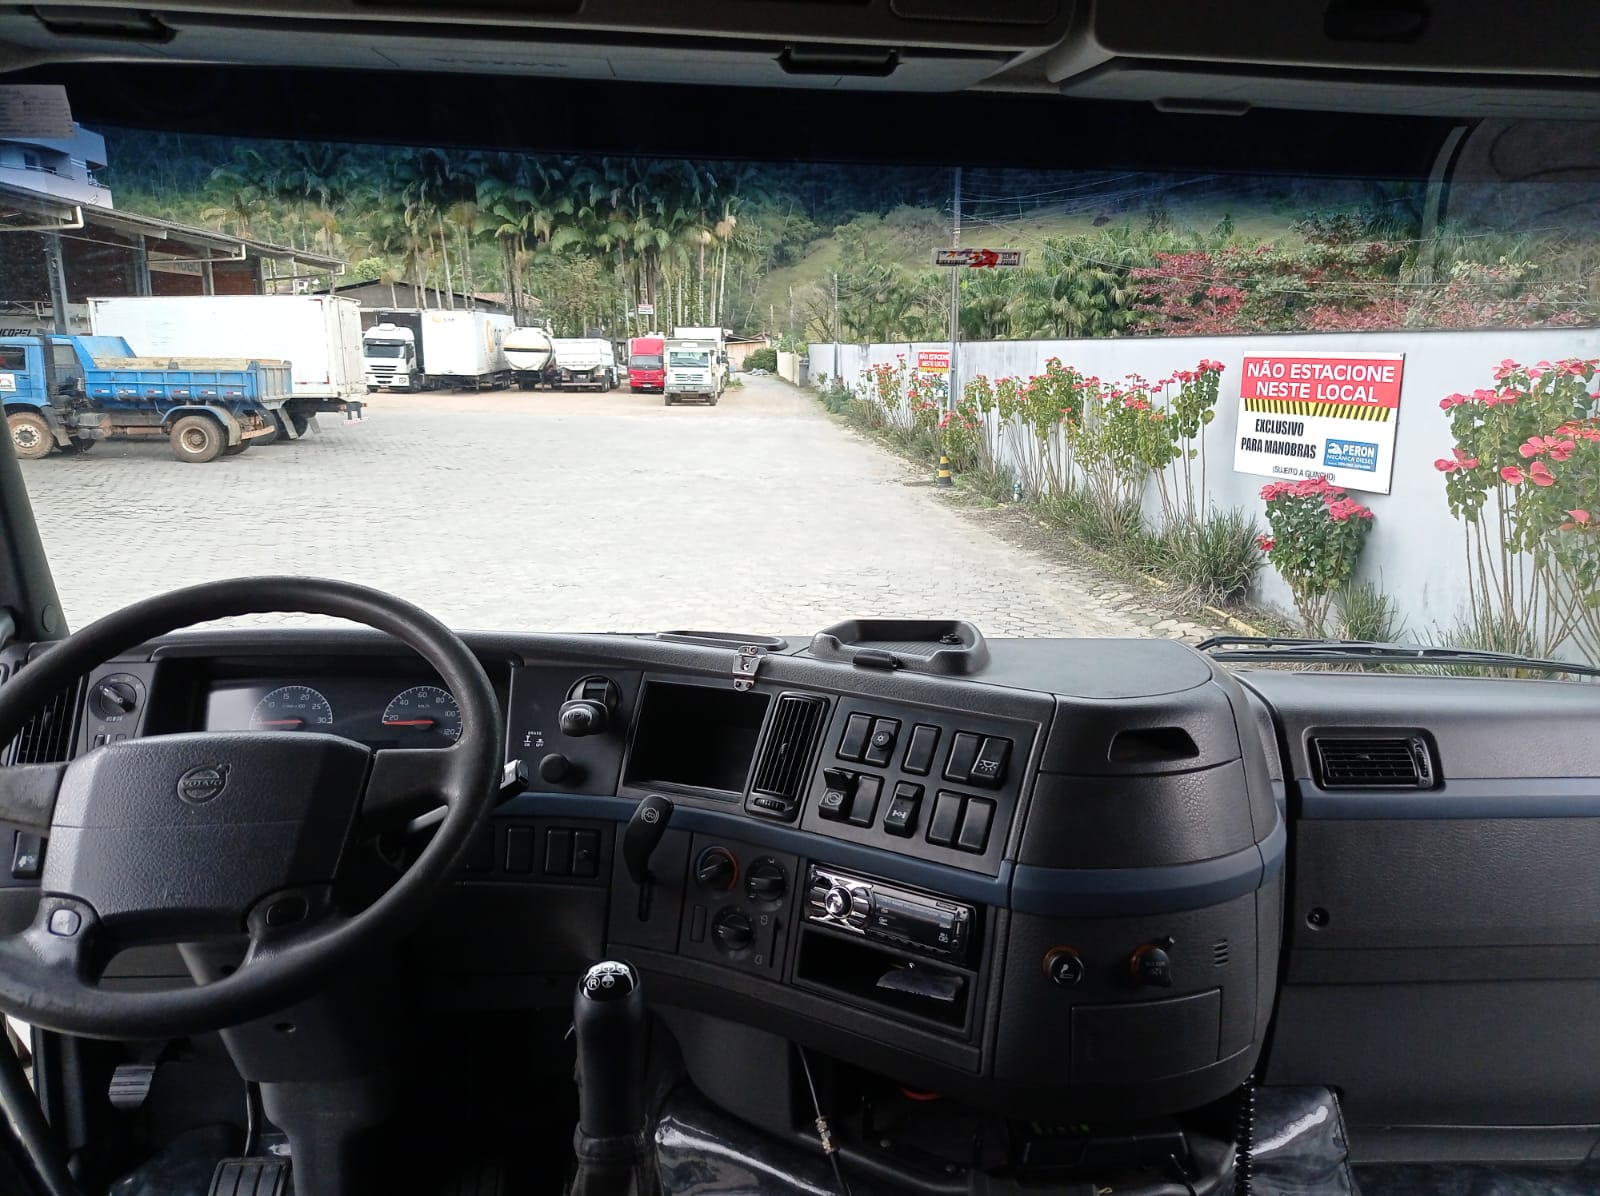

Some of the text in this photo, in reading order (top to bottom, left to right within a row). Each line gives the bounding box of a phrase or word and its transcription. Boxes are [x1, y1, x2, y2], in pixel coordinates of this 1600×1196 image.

[1247, 360, 1395, 383] NÃO ESTACIONE
[1256, 381, 1378, 403] NESTE LOCAL
[1255, 418, 1305, 437] EXCLUSIVO
[1241, 437, 1317, 460] PARA MANOBRAS
[1343, 444, 1375, 458] PERON
[1299, 469, 1305, 477] A
